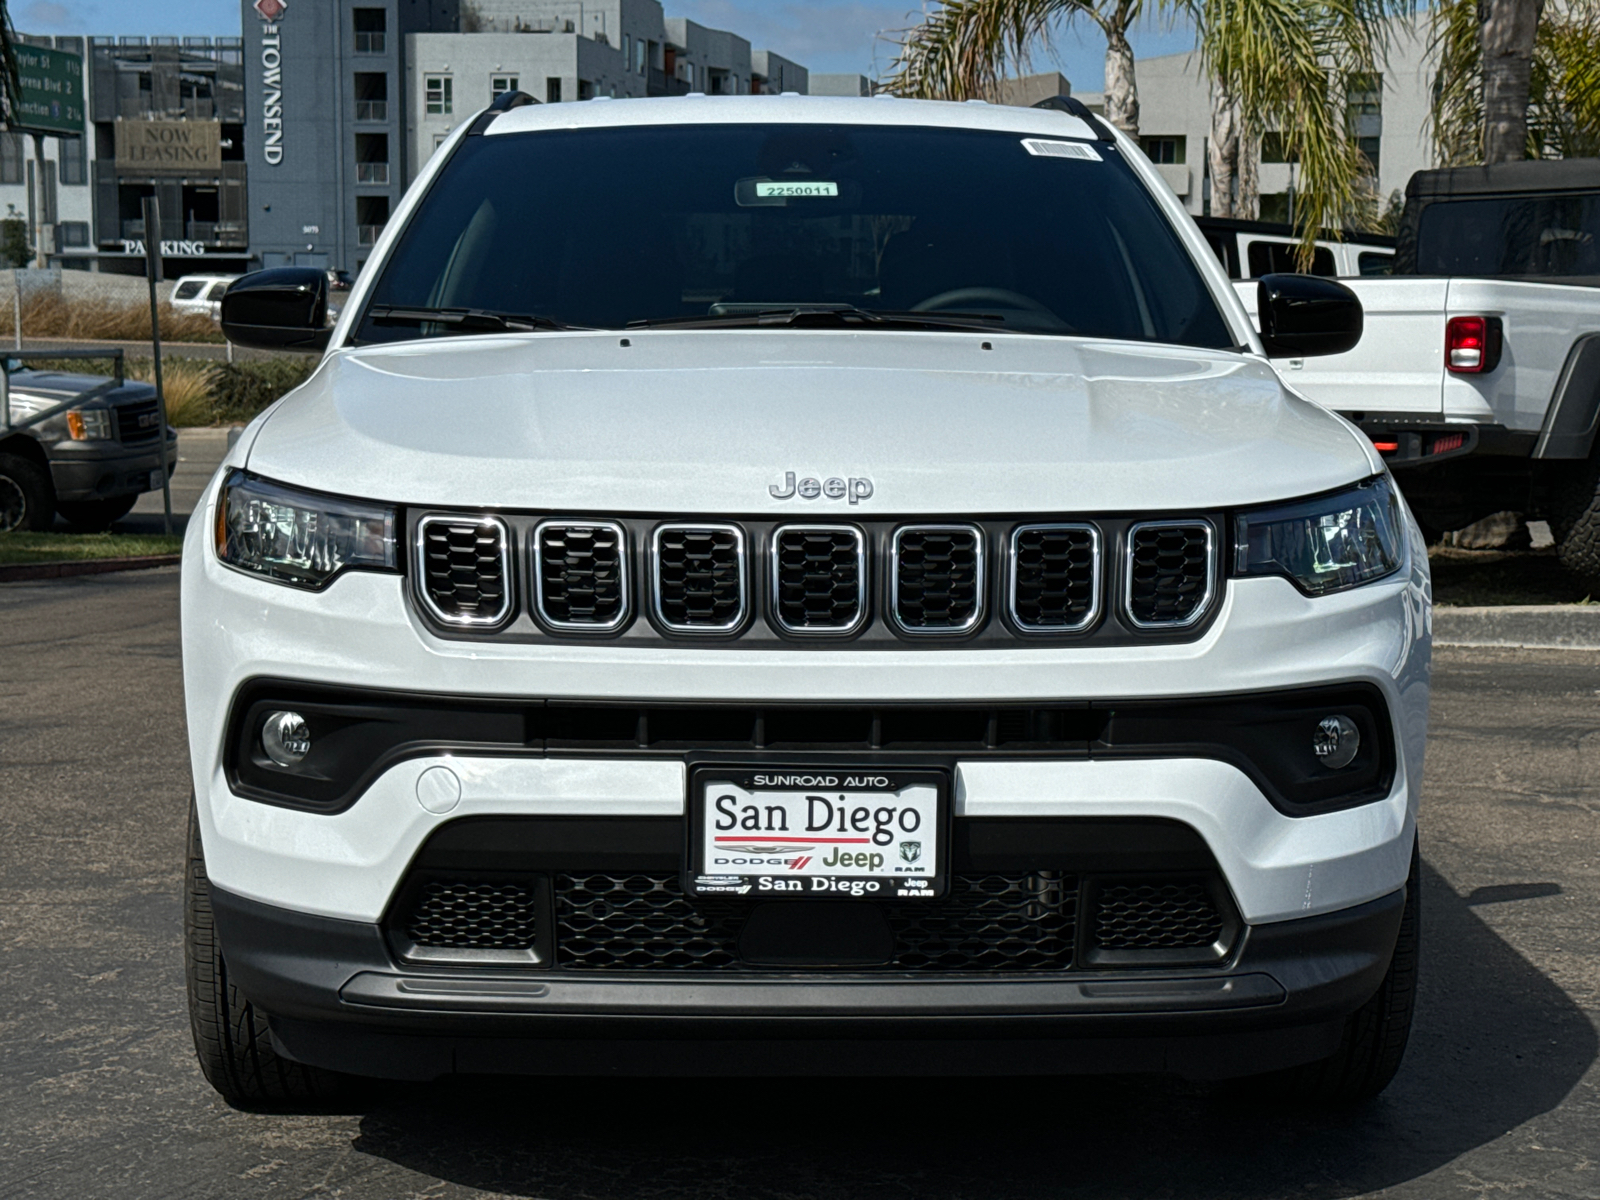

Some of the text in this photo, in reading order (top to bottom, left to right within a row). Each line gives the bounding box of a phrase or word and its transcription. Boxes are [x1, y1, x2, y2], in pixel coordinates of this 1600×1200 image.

[41, 55, 50, 69] St
[19, 77, 42, 89] orena
[66, 82, 73, 94] 2
[262, 34, 283, 165] TOWNSEND
[145, 126, 193, 145] NOW
[129, 146, 209, 163] LEASING
[767, 187, 830, 195] 2250011
[122, 239, 205, 257] PAKING
[768, 471, 874, 505] Jeep
[754, 775, 889, 787] SUNROAD AUTO
[715, 794, 922, 846] San Diego
[714, 858, 797, 866] DODGE
[823, 847, 885, 872] Jeep
[758, 876, 881, 897] San Diego
[904, 878, 929, 889] Jeep
[897, 889, 935, 898] RAM
